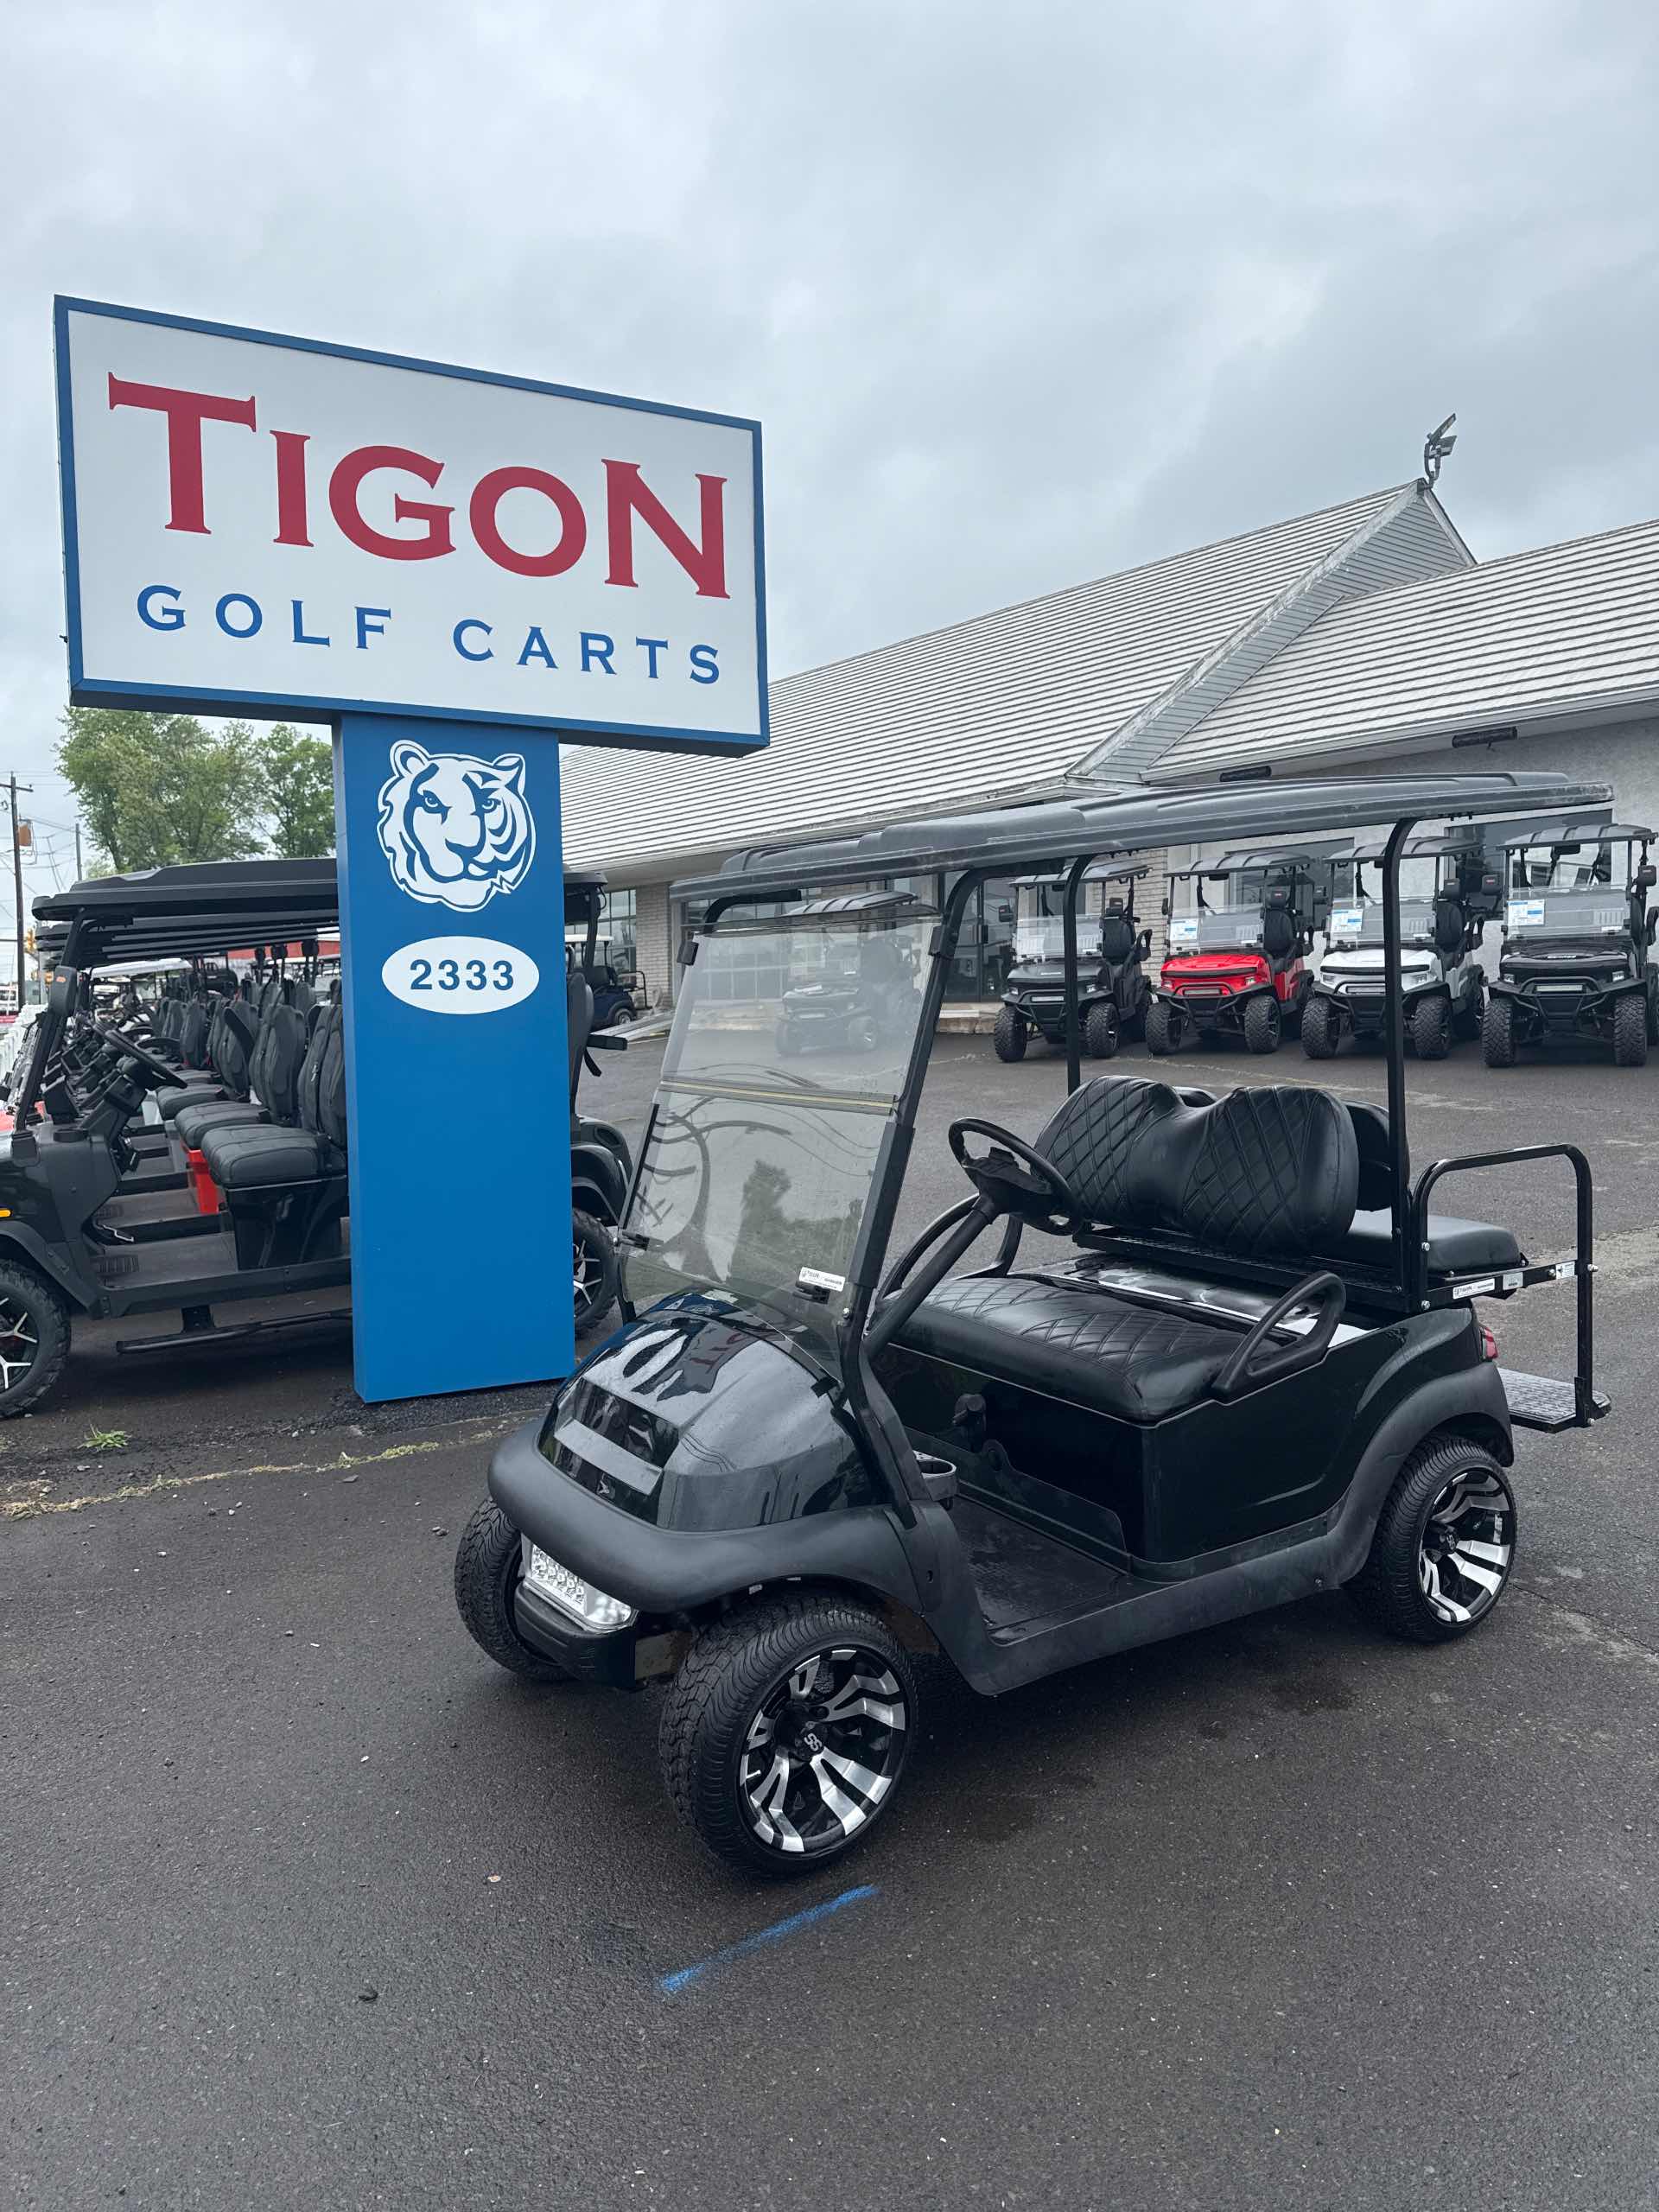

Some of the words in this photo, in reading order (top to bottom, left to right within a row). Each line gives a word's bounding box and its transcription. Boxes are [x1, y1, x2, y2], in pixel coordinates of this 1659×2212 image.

[108, 372, 730, 599] TIGON
[137, 585, 391, 650] GOLF
[452, 619, 720, 684] CARTS
[410, 959, 514, 991] 2333
